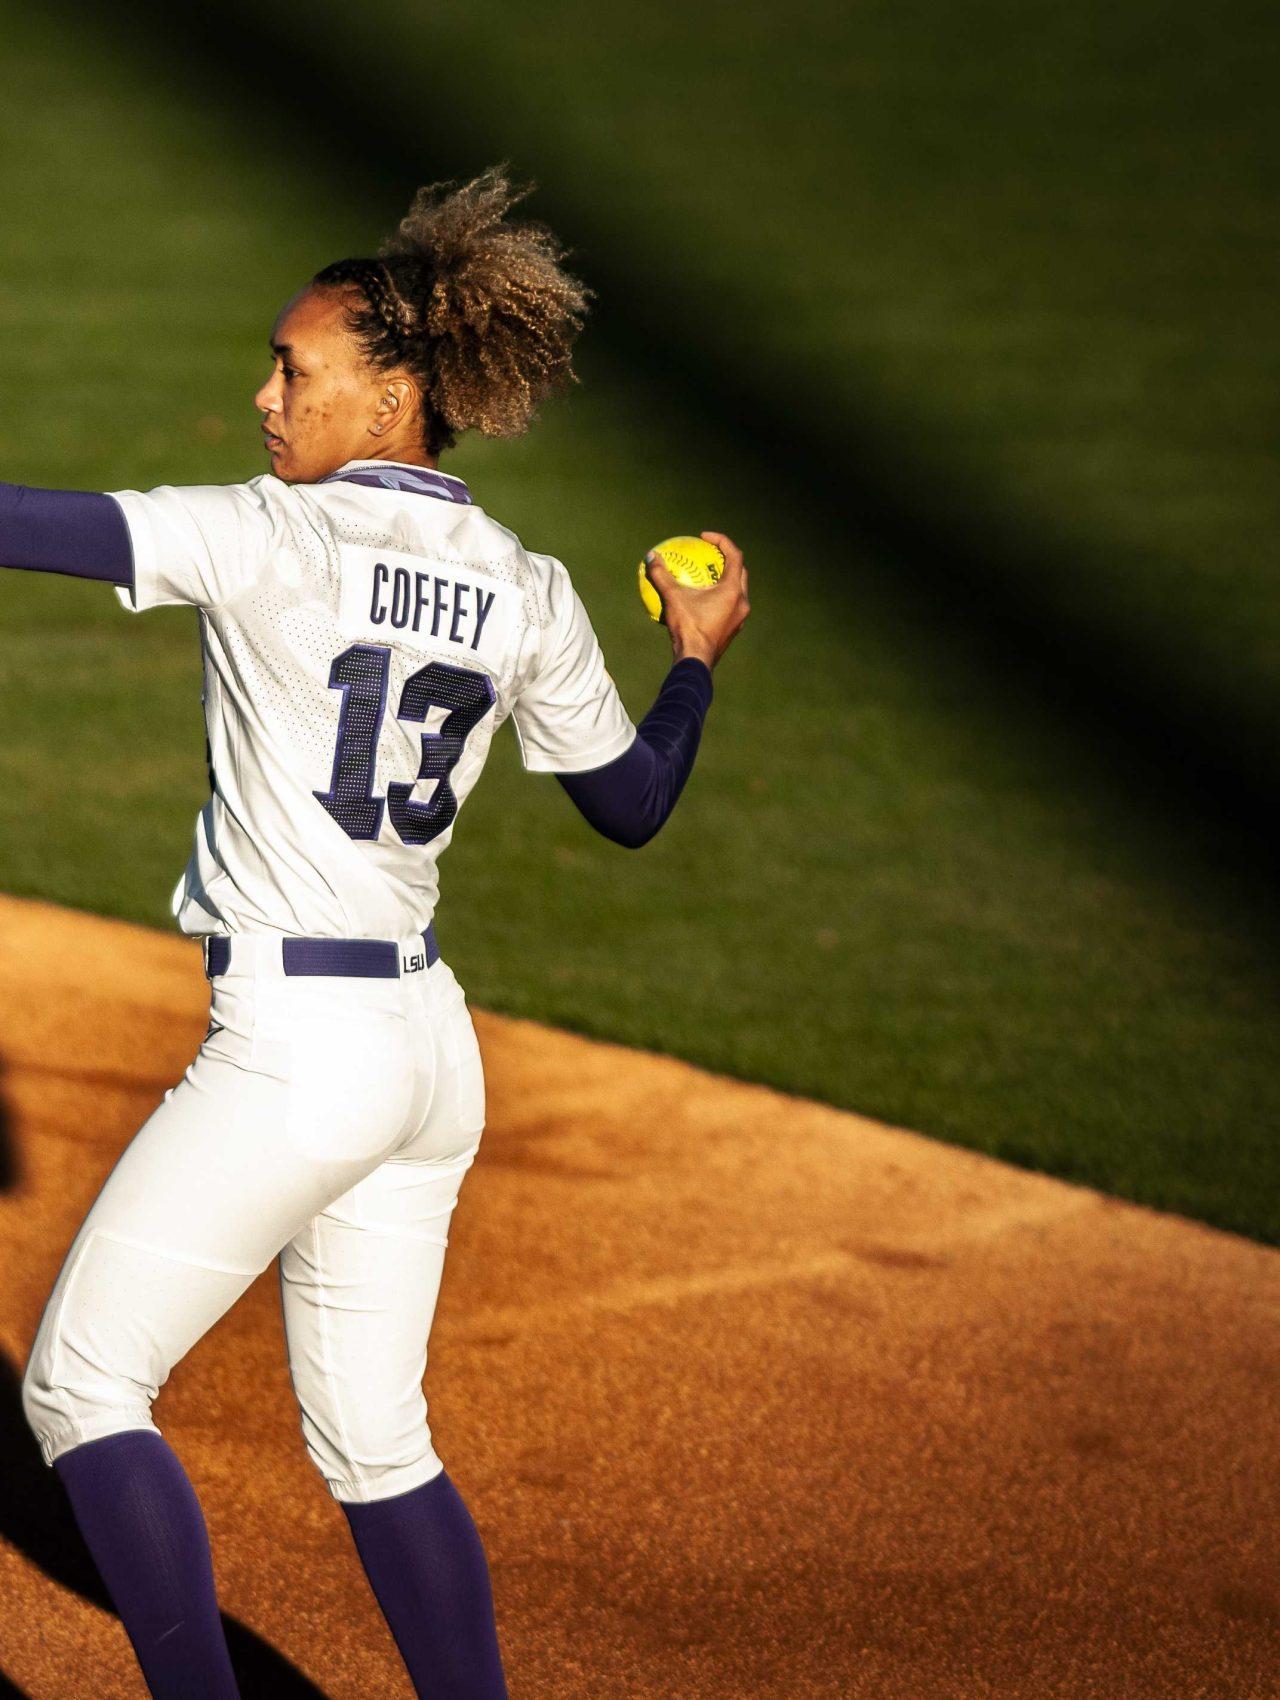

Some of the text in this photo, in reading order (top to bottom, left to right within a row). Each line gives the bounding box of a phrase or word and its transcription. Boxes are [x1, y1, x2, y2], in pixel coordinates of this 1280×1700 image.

[369, 562, 496, 651] COFFEY
[312, 643, 497, 845] 13
[403, 953, 424, 973] LSU
